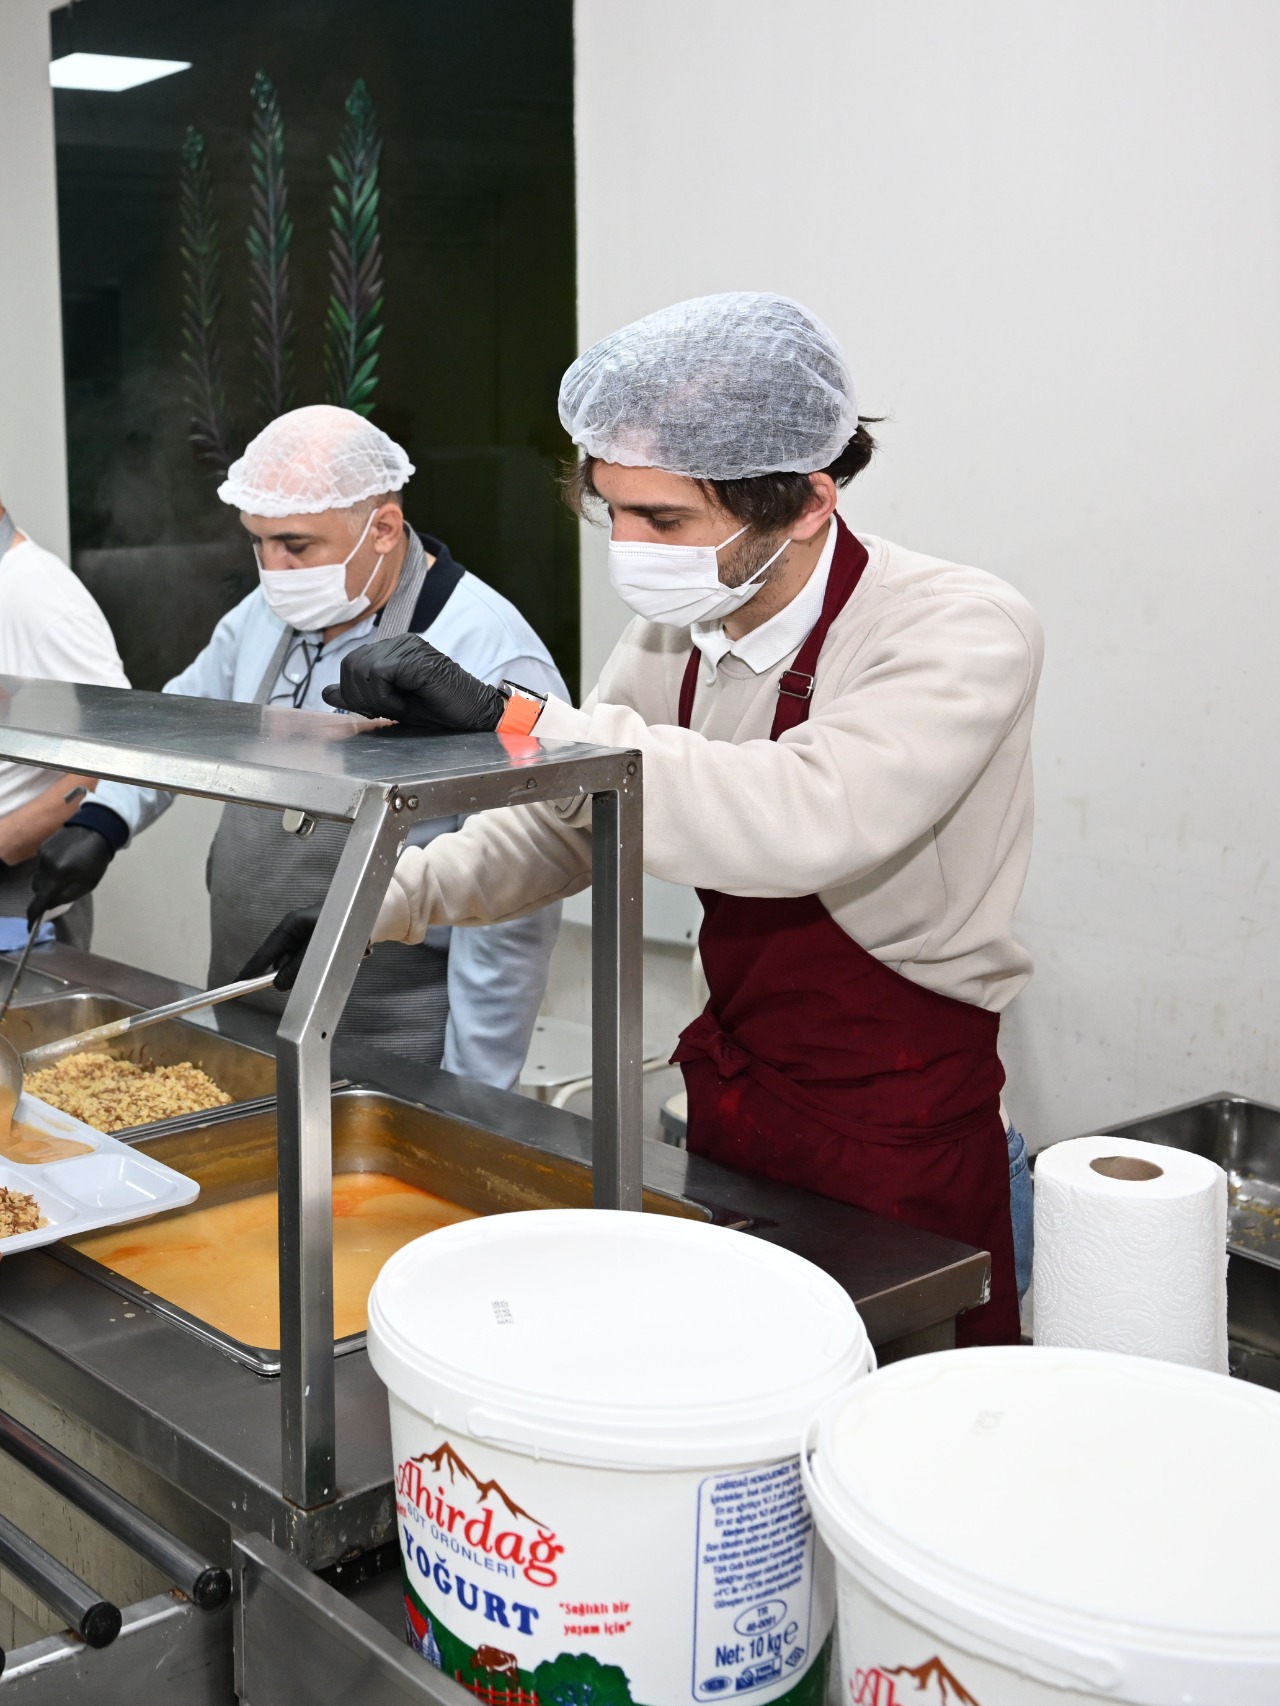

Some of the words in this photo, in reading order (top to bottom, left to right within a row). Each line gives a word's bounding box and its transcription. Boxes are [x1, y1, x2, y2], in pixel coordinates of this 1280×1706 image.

[396, 1460, 565, 1588] Ahirdağ
[407, 1502, 426, 1529] SÜT
[431, 1523, 517, 1580] ÜRÜNLERİ
[402, 1523, 540, 1636] YOĞURT
[612, 1600, 630, 1614] bir
[715, 1643, 745, 1668] Net:
[750, 1636, 764, 1659] 10
[767, 1632, 782, 1657] kg
